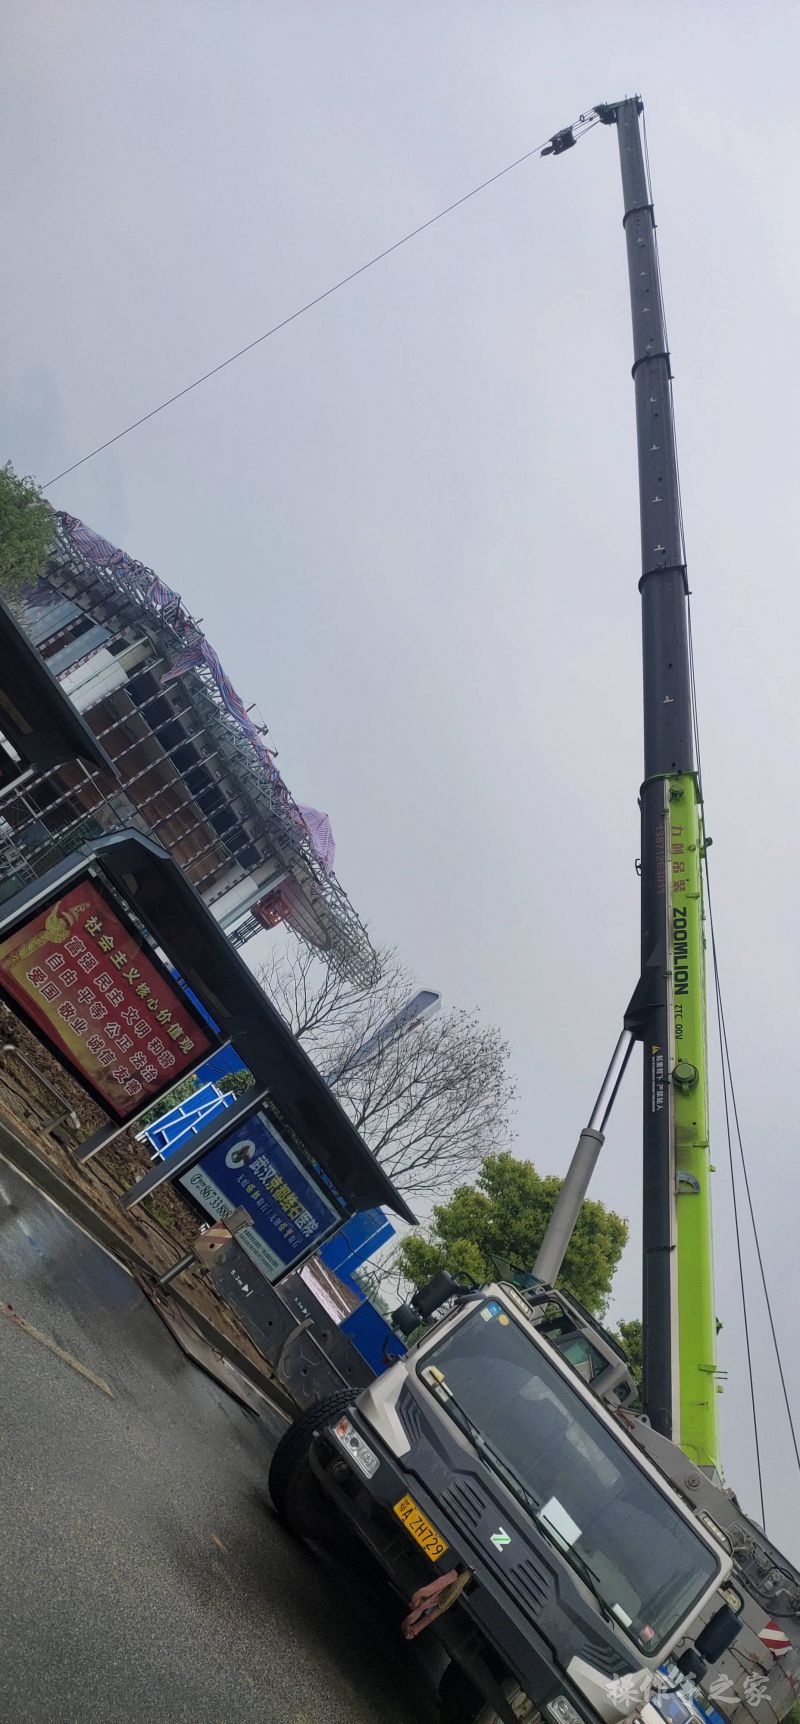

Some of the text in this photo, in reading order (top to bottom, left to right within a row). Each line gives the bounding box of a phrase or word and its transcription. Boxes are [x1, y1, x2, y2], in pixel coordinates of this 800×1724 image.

[64, 935, 176, 1069] 富强 民主 文明 和谐
[84, 916, 195, 1054] 社会主义核心价值观
[673, 906, 689, 995] ZOOMLION
[26, 966, 143, 1096] 爱国 敬业 诚信 友善
[46, 952, 158, 1083] 自由 平等 公正 法治
[249, 1154, 319, 1238] 武汉京都结石医院
